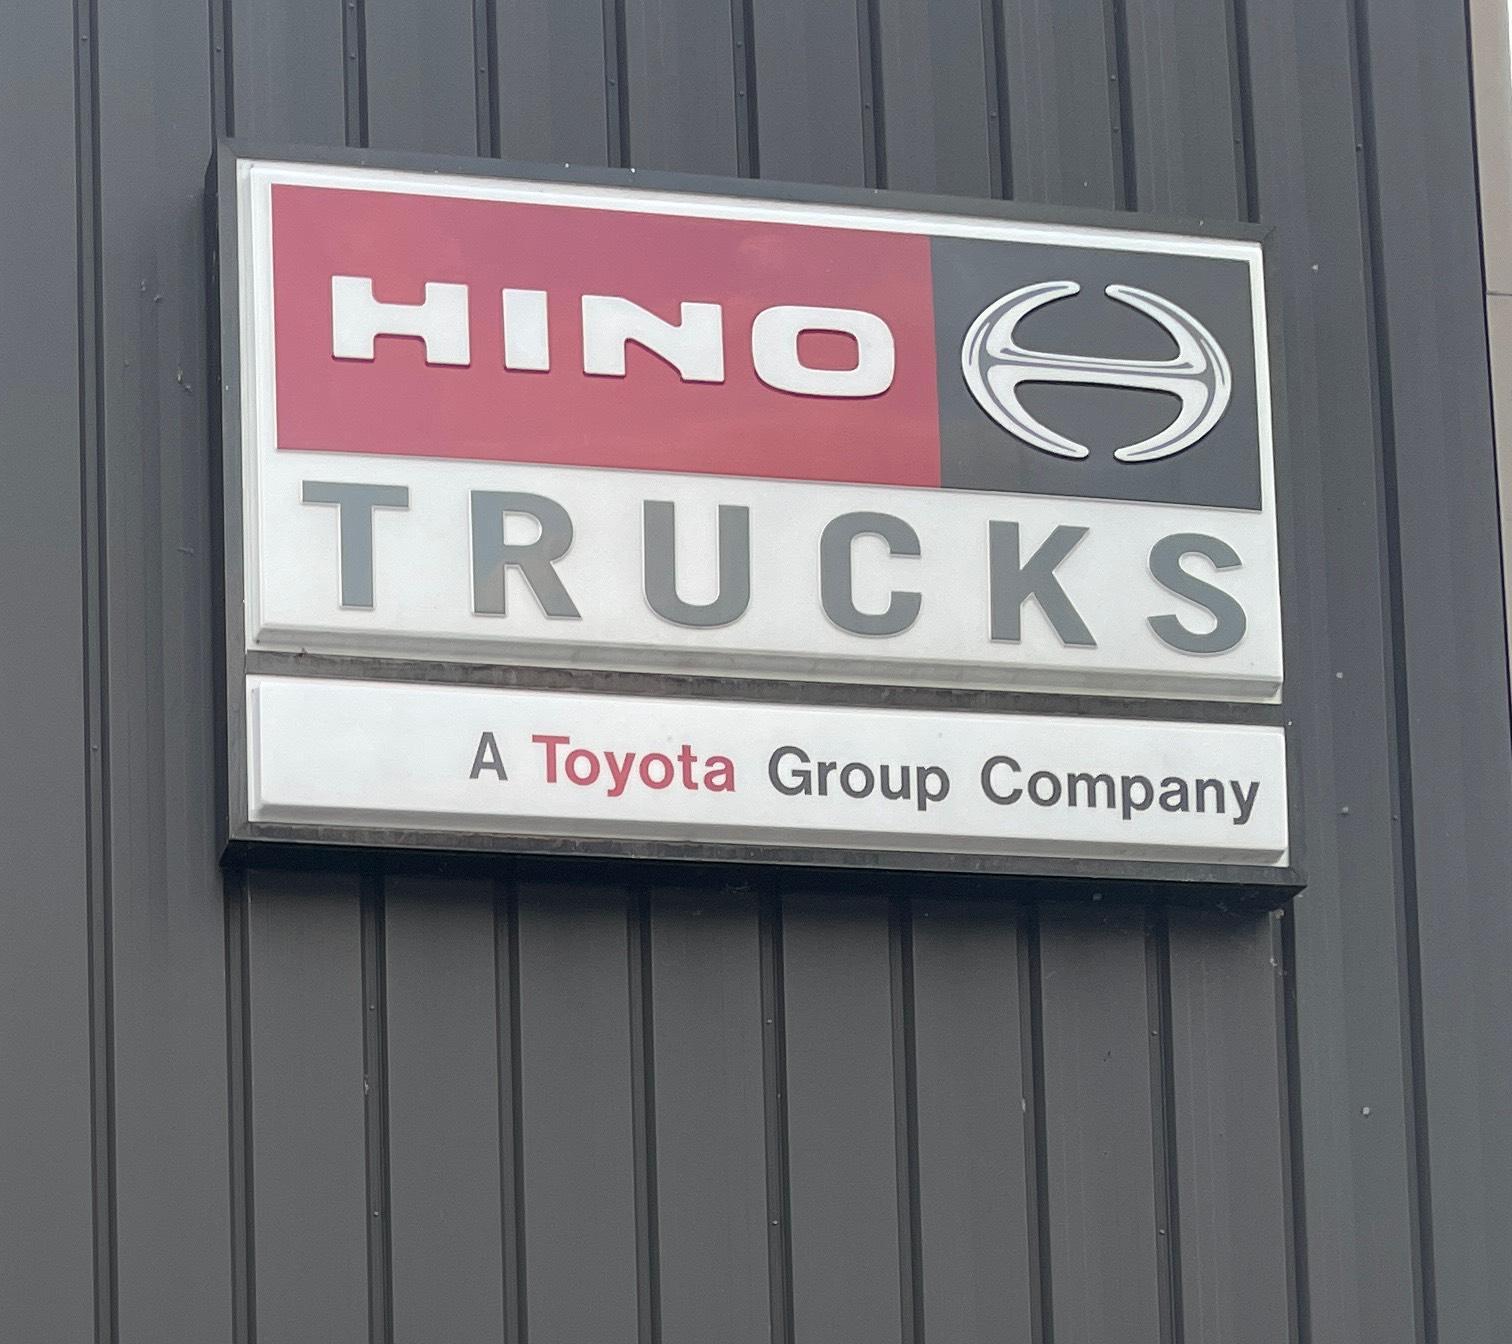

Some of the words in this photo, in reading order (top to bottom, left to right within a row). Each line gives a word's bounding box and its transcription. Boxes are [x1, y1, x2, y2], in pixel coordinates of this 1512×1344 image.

[331, 274, 896, 397] HINO
[301, 479, 1248, 656] TRUCKS
[468, 731, 508, 782] A
[531, 734, 737, 798] Toyota
[768, 745, 951, 812] Group
[980, 755, 1261, 826] Company
